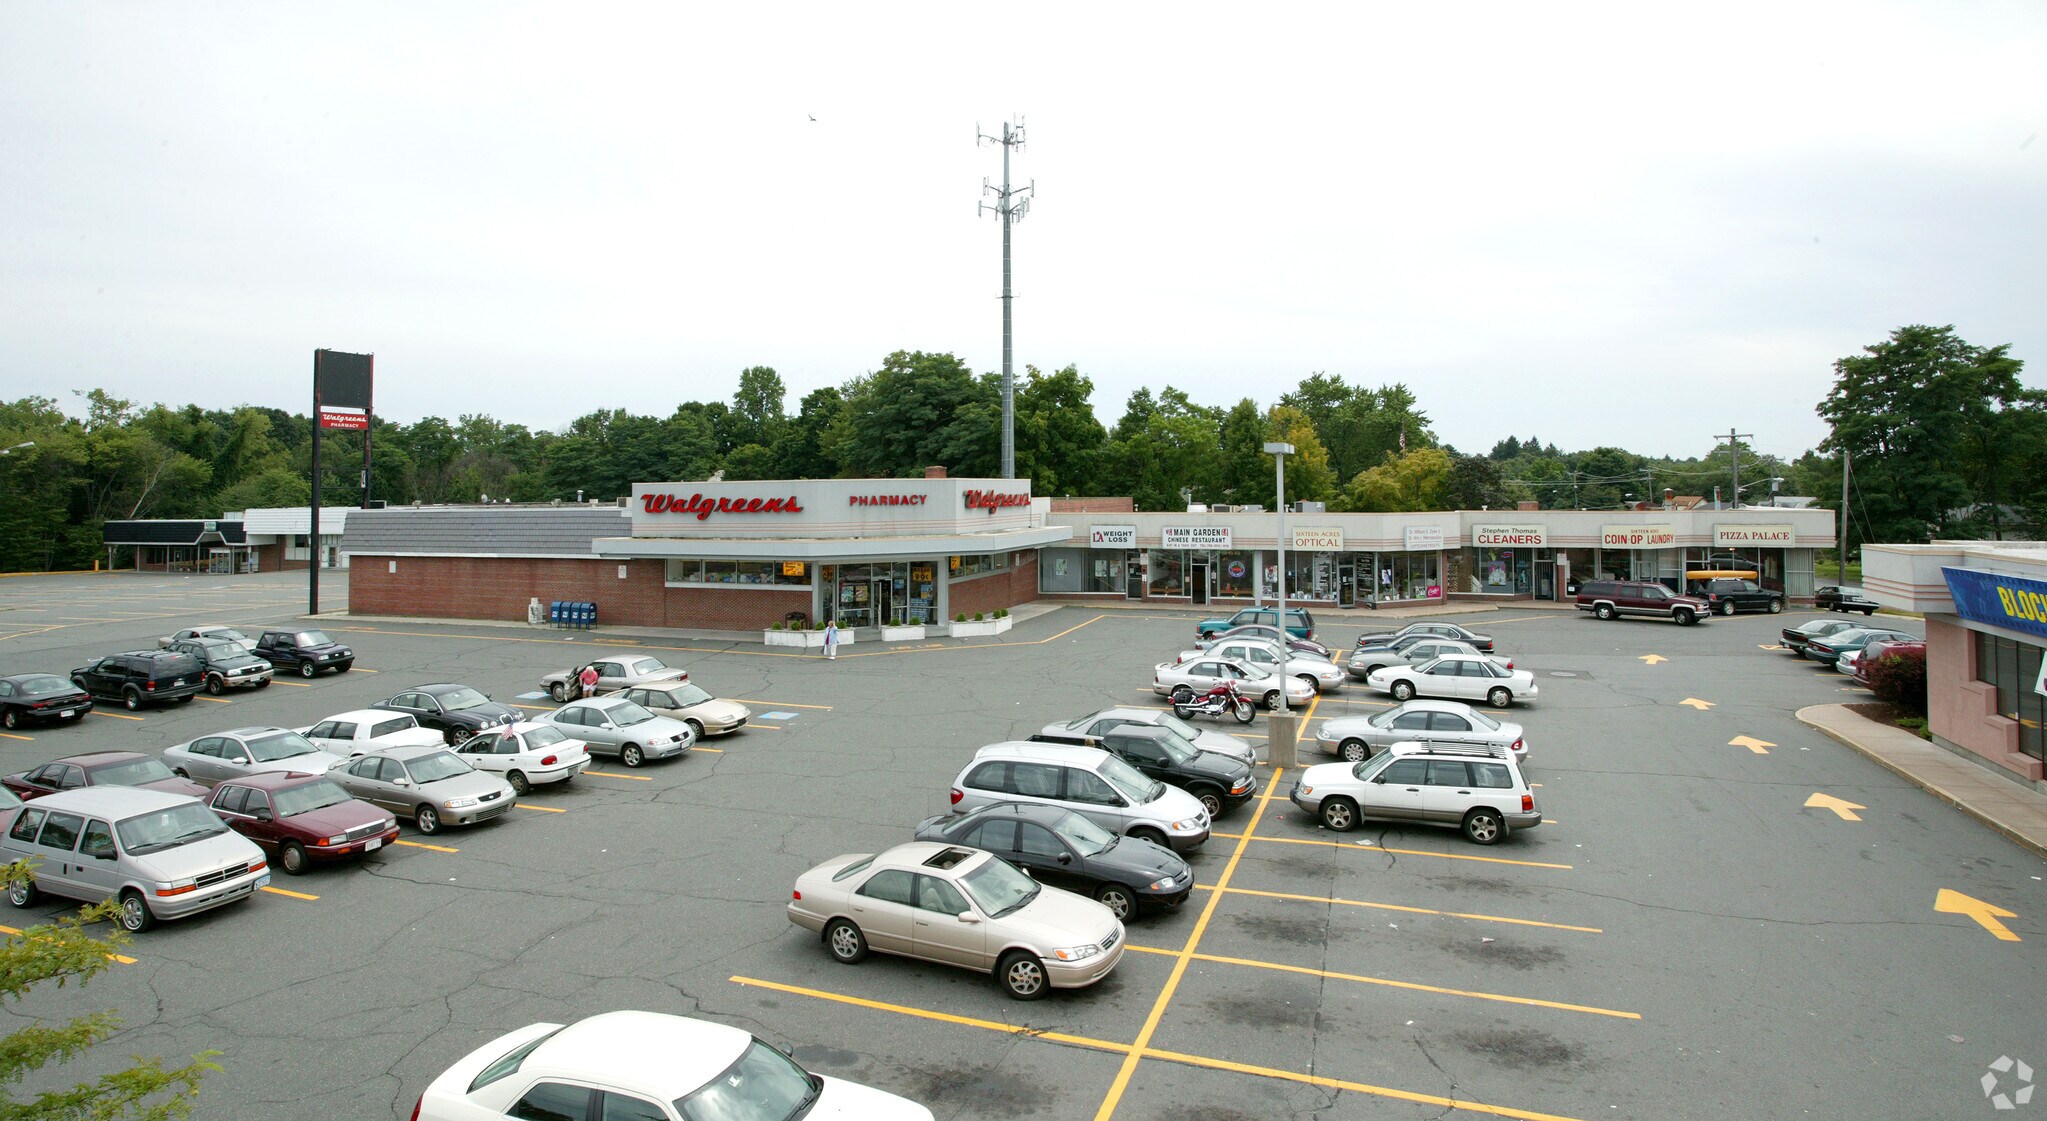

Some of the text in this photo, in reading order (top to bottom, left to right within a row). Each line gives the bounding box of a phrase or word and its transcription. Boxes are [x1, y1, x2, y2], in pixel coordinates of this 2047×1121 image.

[323, 414, 366, 422] Walgreens
[849, 493, 928, 507] PHARMACY
[963, 489, 1031, 515] Walgreens
[640, 493, 804, 520] Walgreens
[1174, 528, 1190, 536] MAIN
[1193, 528, 1220, 536] GARDEN
[1720, 531, 1789, 540] PIZZA PALACE
[1295, 538, 1339, 547] OPTICAL
[1478, 534, 1542, 544] CLEANERS
[1604, 534, 1674, 544] COIN-OP LAUNDRY
